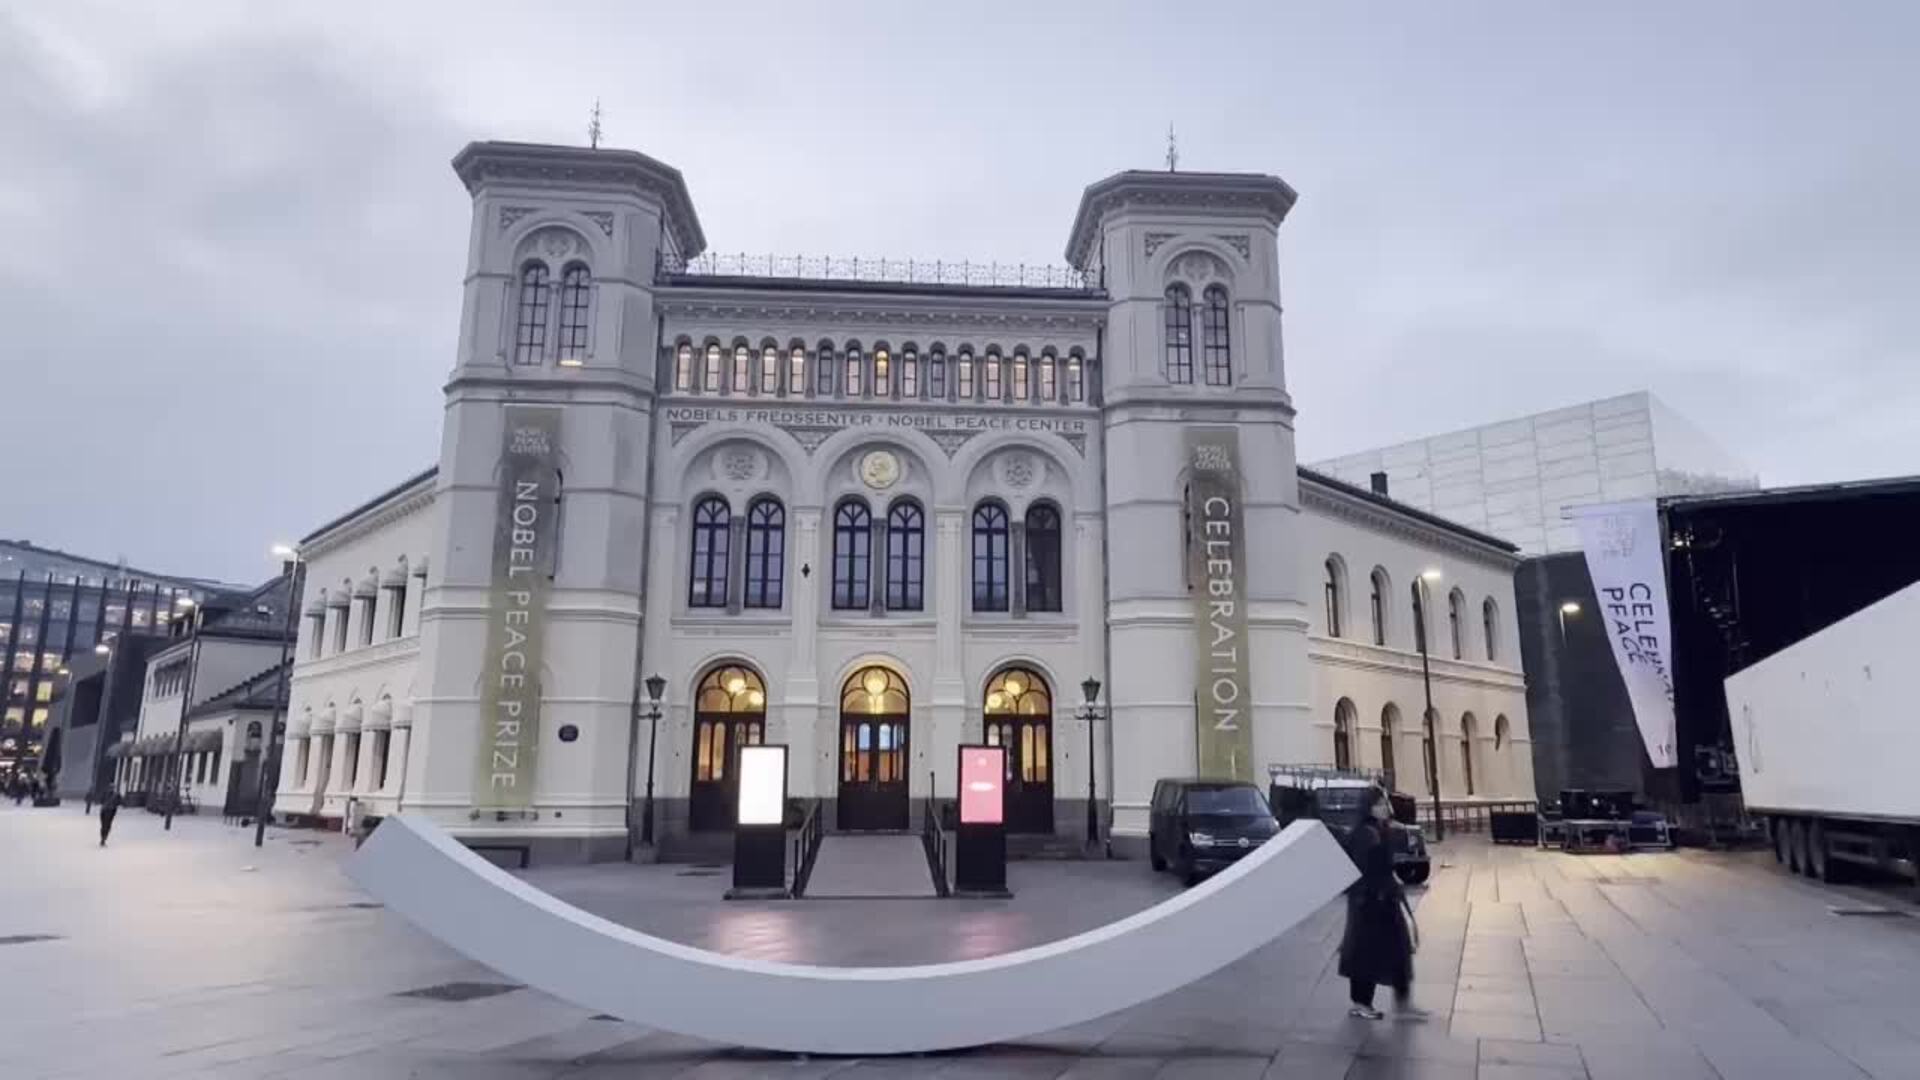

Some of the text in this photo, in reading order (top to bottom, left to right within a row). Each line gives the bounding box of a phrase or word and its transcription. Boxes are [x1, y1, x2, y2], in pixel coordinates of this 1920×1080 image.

[667, 408, 1084, 431] NOBELS FREDSSENTER NOBEL PEACE CENTER
[491, 480, 539, 789] NOBEL PEACE PRIZE
[1204, 496, 1239, 731] CELEBRATION
